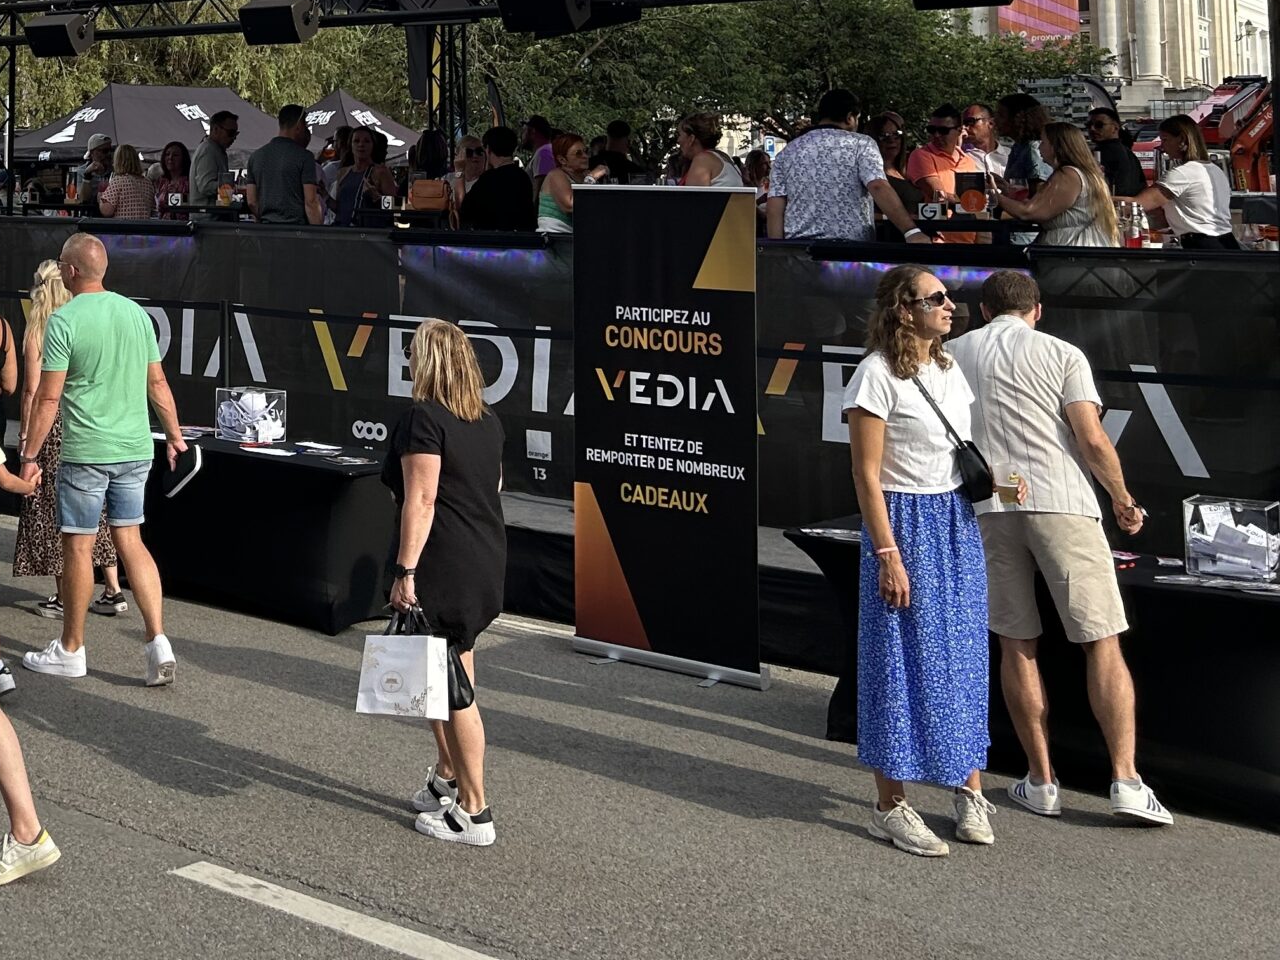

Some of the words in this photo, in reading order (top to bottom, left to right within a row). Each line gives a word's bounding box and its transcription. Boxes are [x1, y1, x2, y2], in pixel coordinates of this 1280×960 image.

[615, 305, 689, 325] PARTICIPEZ
[691, 311, 711, 326] AU
[605, 324, 723, 356] CONCOURS
[309, 308, 574, 416] VEDI
[595, 367, 735, 414] VEDIA
[624, 432, 639, 446] ET
[640, 434, 685, 453] TENTEZ
[687, 440, 703, 455] DE
[532, 467, 547, 481] 13
[586, 447, 656, 469] REMPORTER
[657, 456, 674, 471] DE
[676, 458, 746, 481] NOMBREUX
[620, 482, 709, 514] CADEAUX
